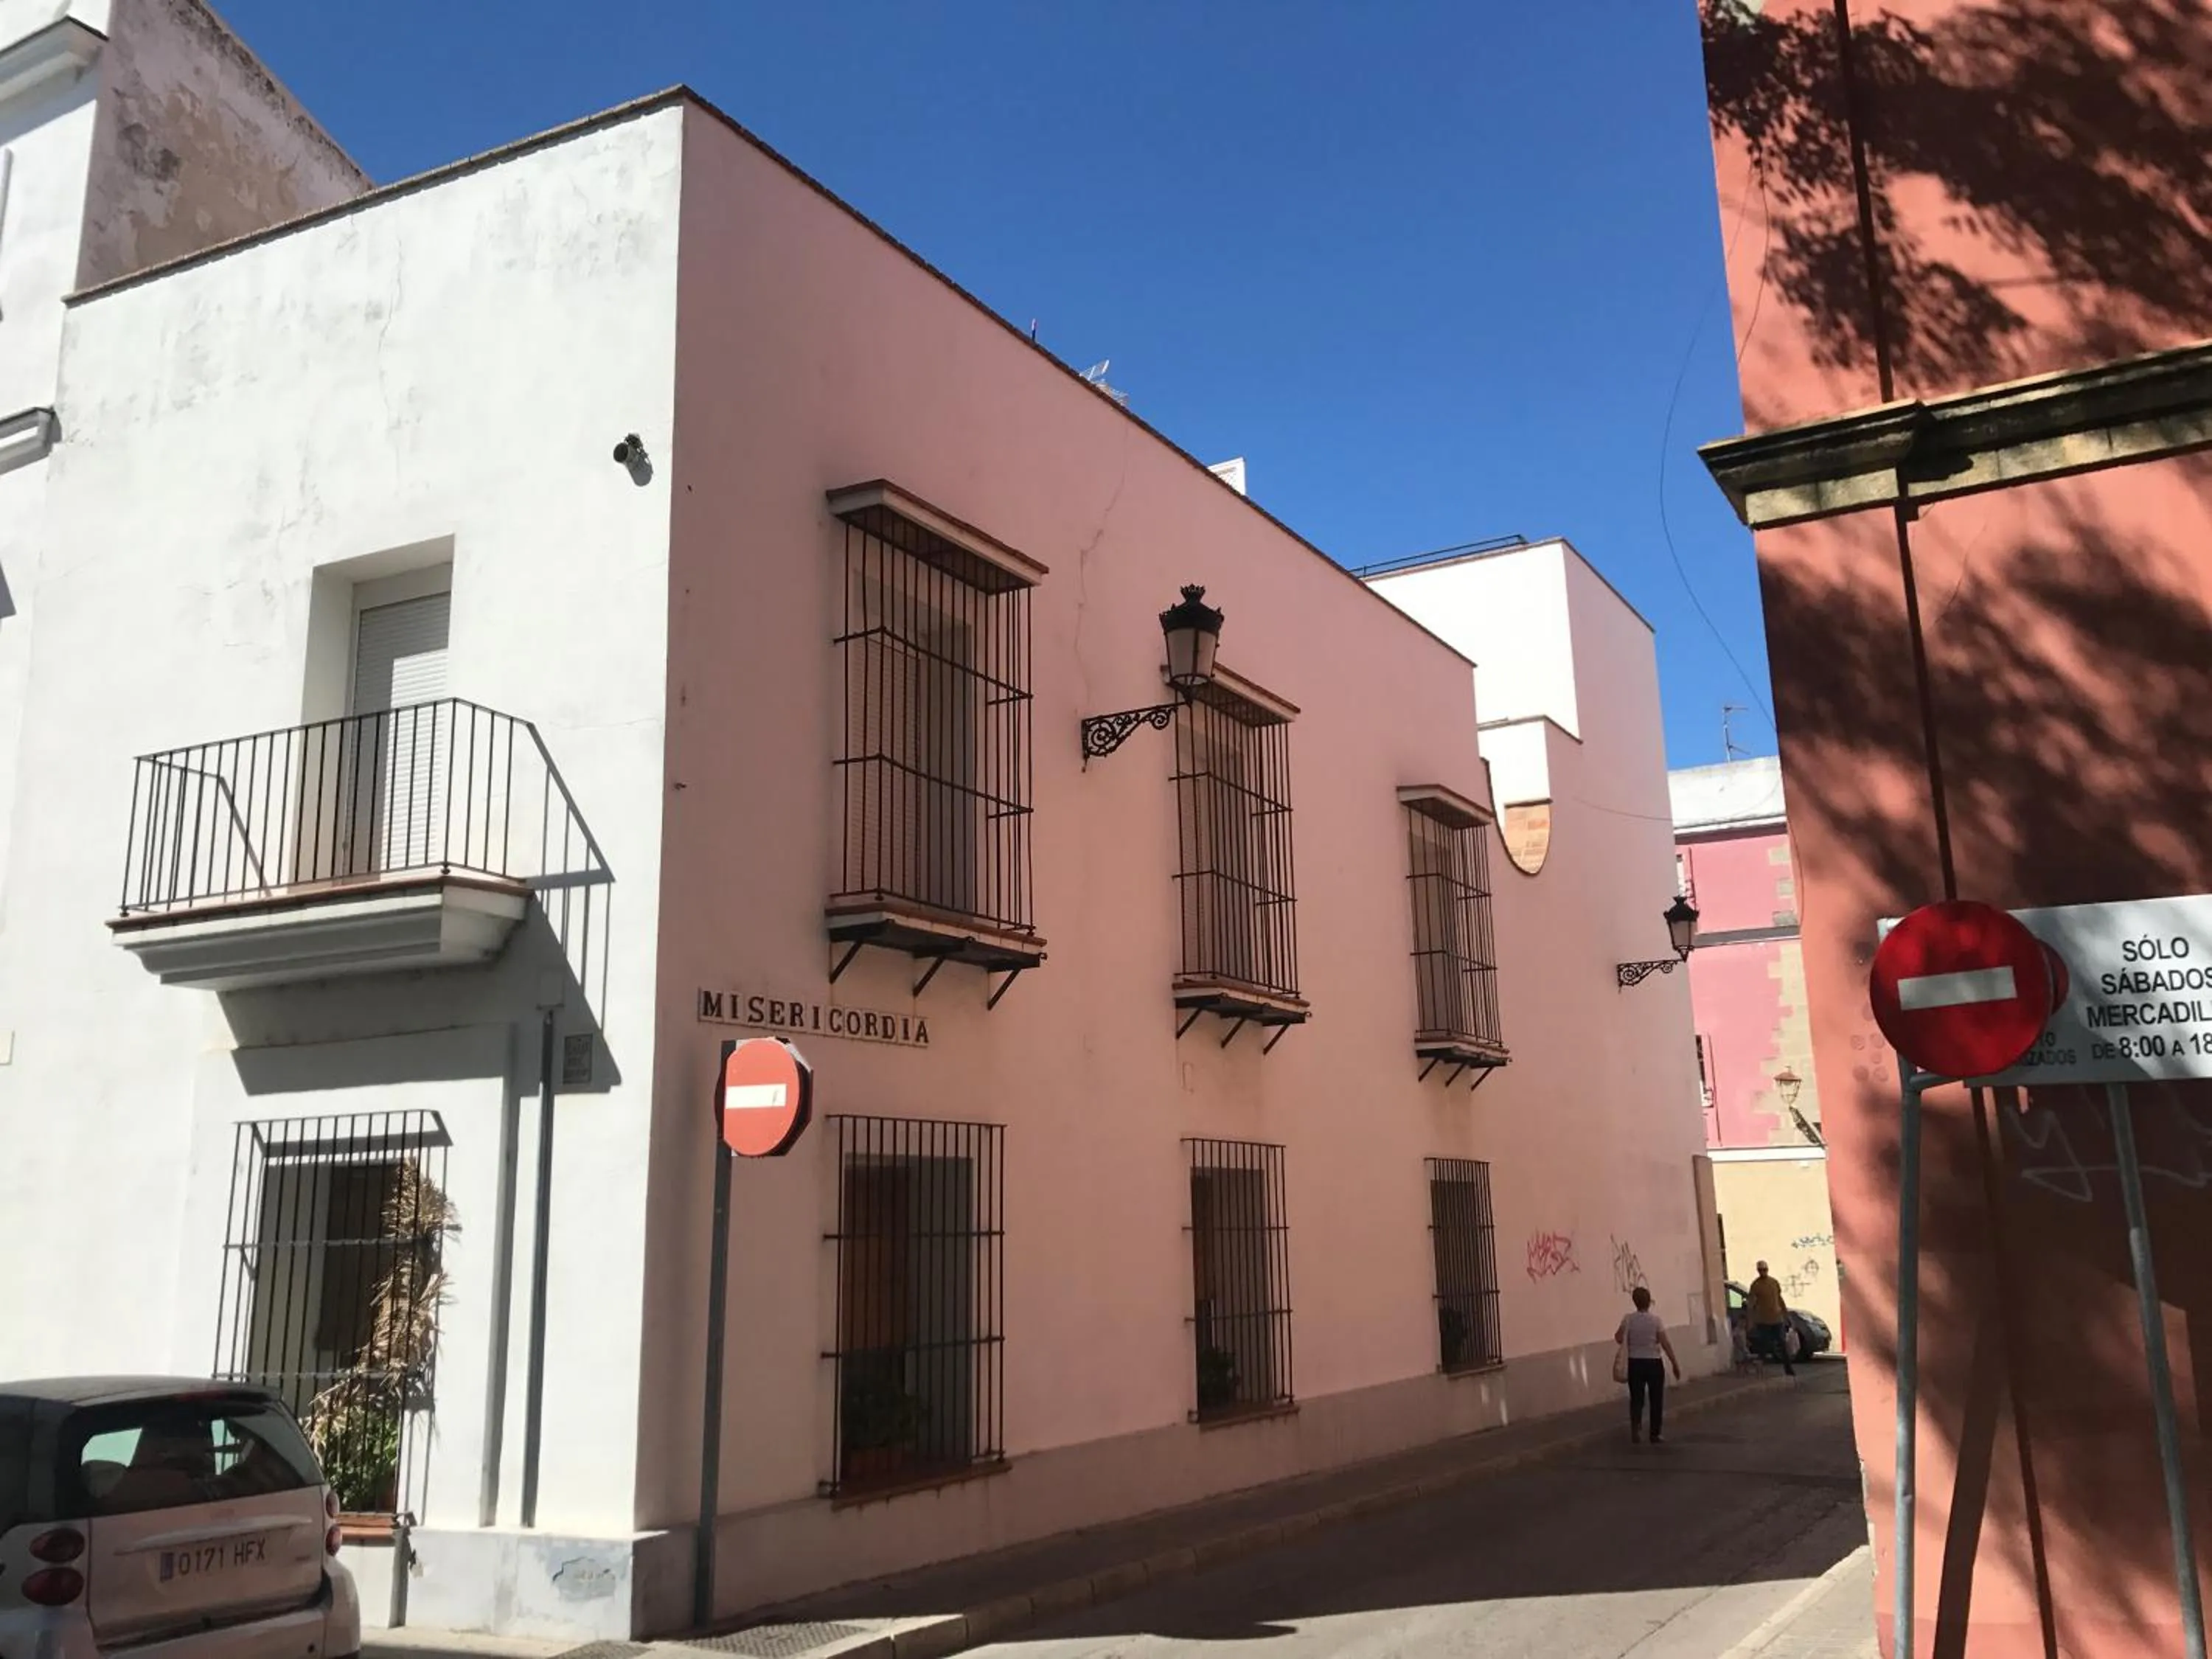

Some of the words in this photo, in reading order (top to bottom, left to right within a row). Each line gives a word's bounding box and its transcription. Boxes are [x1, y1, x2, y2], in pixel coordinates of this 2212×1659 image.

[2122, 934, 2189, 962] SÓLO
[2101, 967, 2212, 995] SÁBADOS
[703, 990, 929, 1043] MISERICORDIA
[2087, 1000, 2212, 1028] MERCADIL
[2092, 1042, 2116, 1060] DE
[2119, 1035, 2166, 1059] 8:00
[2171, 1040, 2185, 1056] A
[178, 1547, 224, 1576] 0171
[234, 1537, 265, 1567] HFX
